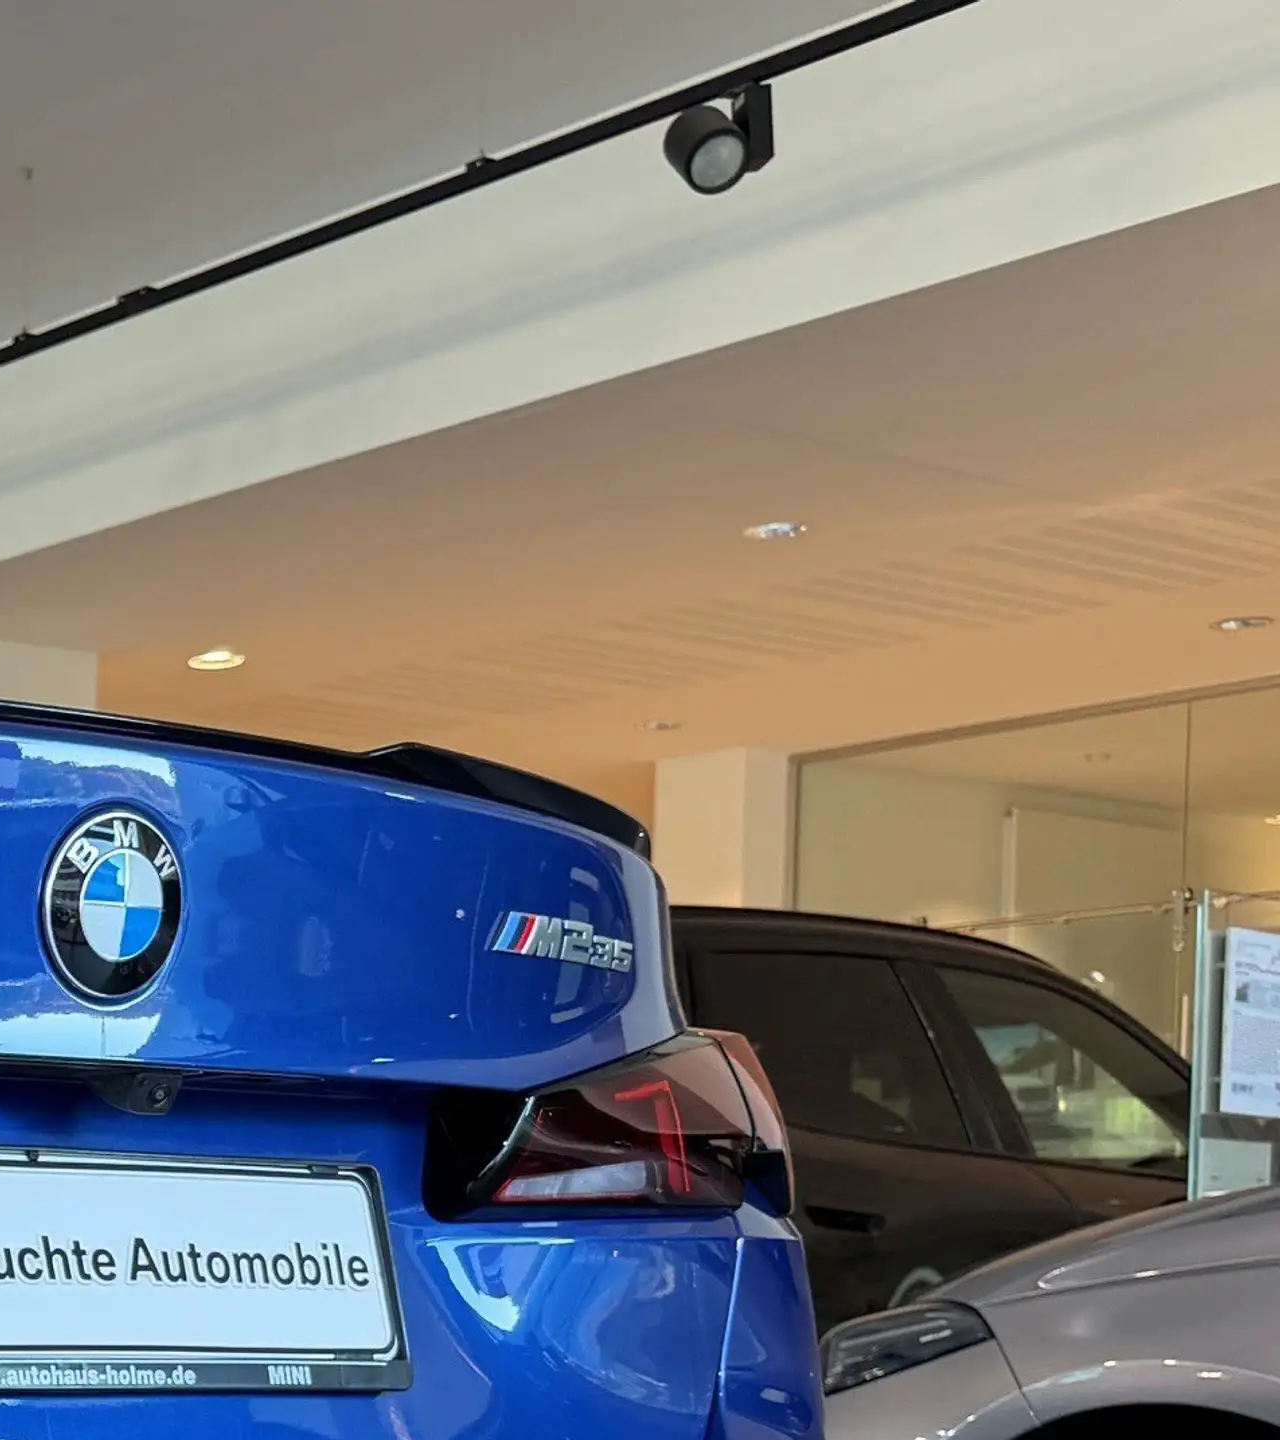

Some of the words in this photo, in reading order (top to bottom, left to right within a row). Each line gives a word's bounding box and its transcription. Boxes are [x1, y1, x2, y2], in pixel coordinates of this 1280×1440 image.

[66, 819, 177, 877] BMW
[520, 912, 633, 973] M235
[129, 1237, 370, 1287] Automobile
[267, 1365, 313, 1386] MINI
